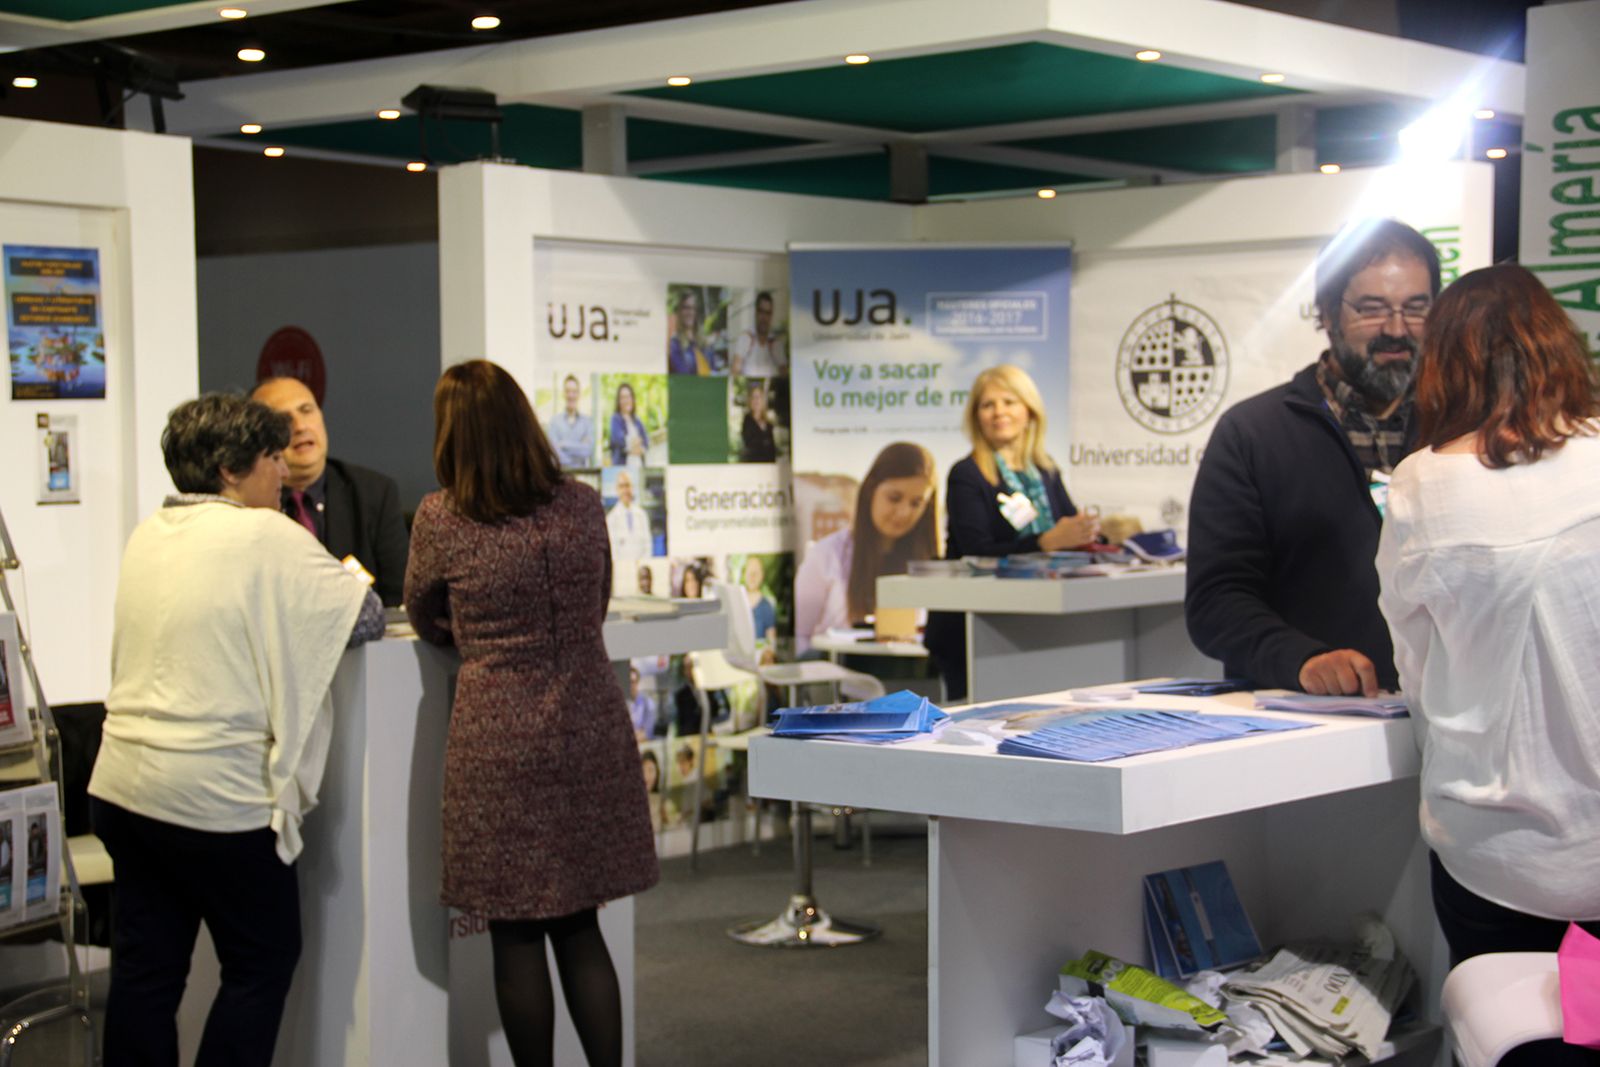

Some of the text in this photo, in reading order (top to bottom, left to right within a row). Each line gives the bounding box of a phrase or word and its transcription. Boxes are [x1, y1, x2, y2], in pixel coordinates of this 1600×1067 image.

[813, 359, 942, 384] Voy a sacar
[813, 387, 835, 408] lo
[841, 386, 909, 413] mejor
[915, 386, 943, 407] de
[1070, 442, 1190, 466] Universidad
[685, 481, 787, 511] Generación
